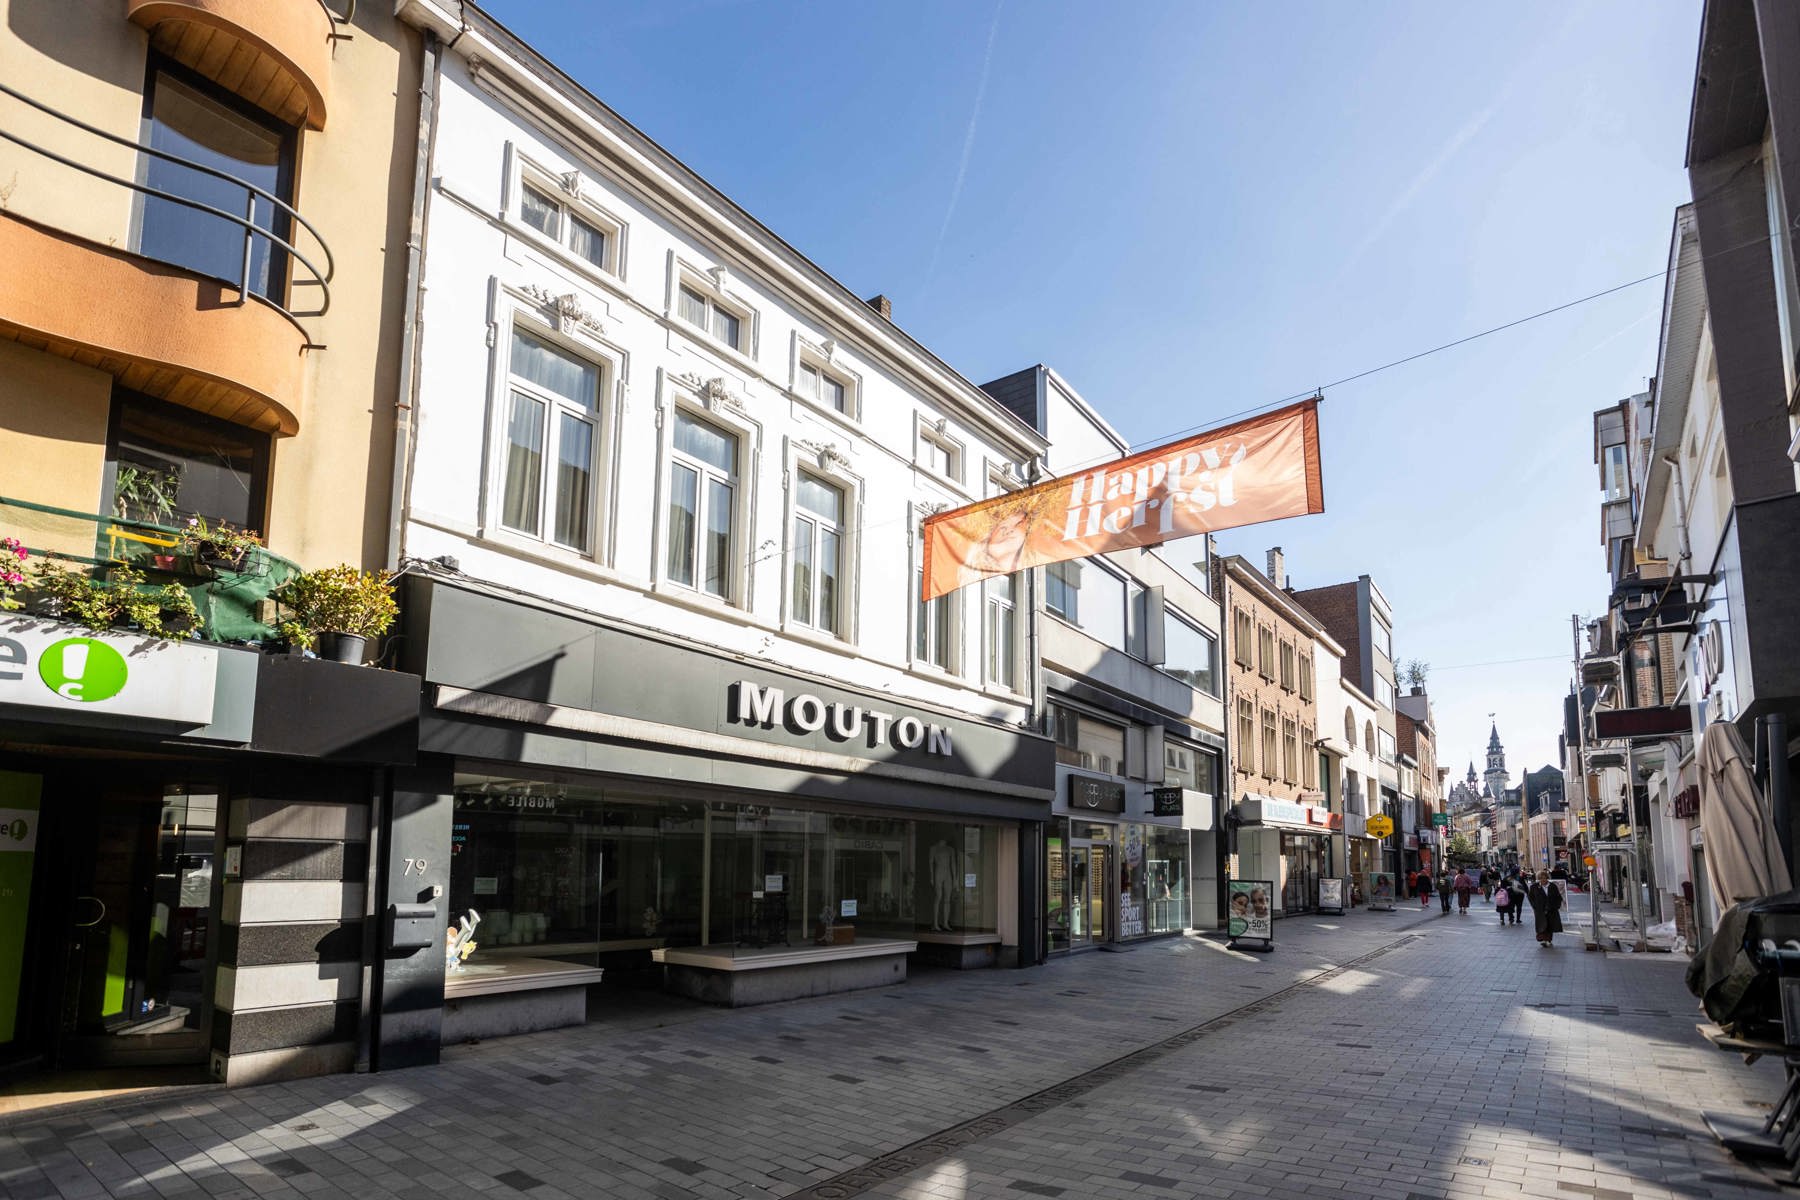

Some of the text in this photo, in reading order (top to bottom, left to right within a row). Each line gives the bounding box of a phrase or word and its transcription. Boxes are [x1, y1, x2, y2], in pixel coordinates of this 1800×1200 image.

[1067, 442, 1248, 509] Happy
[1062, 463, 1239, 542] Herfst
[730, 680, 953, 756] MOUTON
[403, 858, 428, 876] 79
[1121, 892, 1131, 907] SEE
[1121, 906, 1140, 922] SPORT
[1249, 919, 1269, 929] -50%
